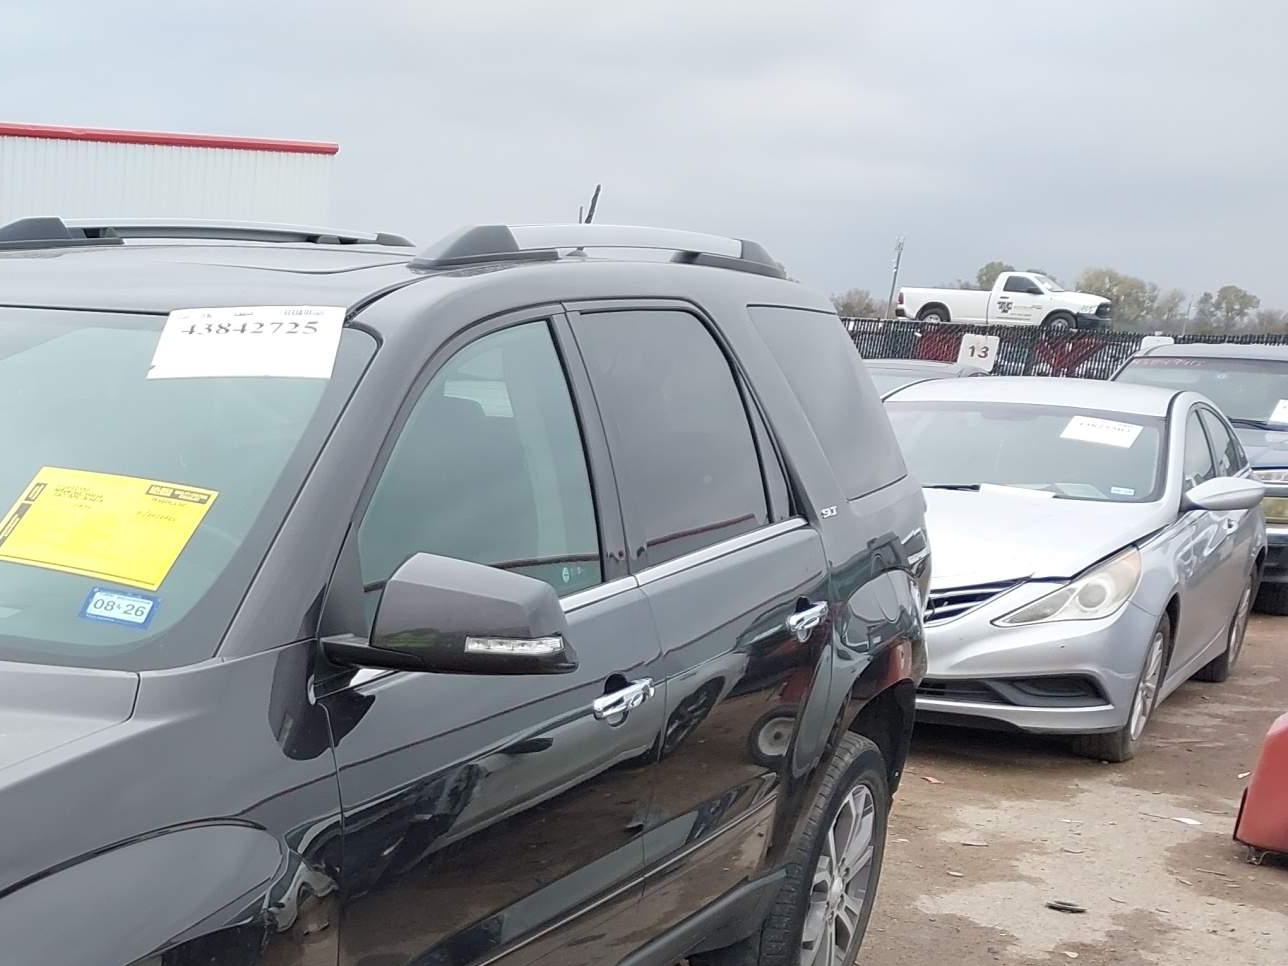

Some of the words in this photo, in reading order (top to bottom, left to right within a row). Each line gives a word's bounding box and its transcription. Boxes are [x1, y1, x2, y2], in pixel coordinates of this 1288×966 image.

[181, 321, 320, 336] 43842725
[968, 345, 990, 359] 13
[93, 598, 116, 612] 08
[123, 603, 146, 617] 26
